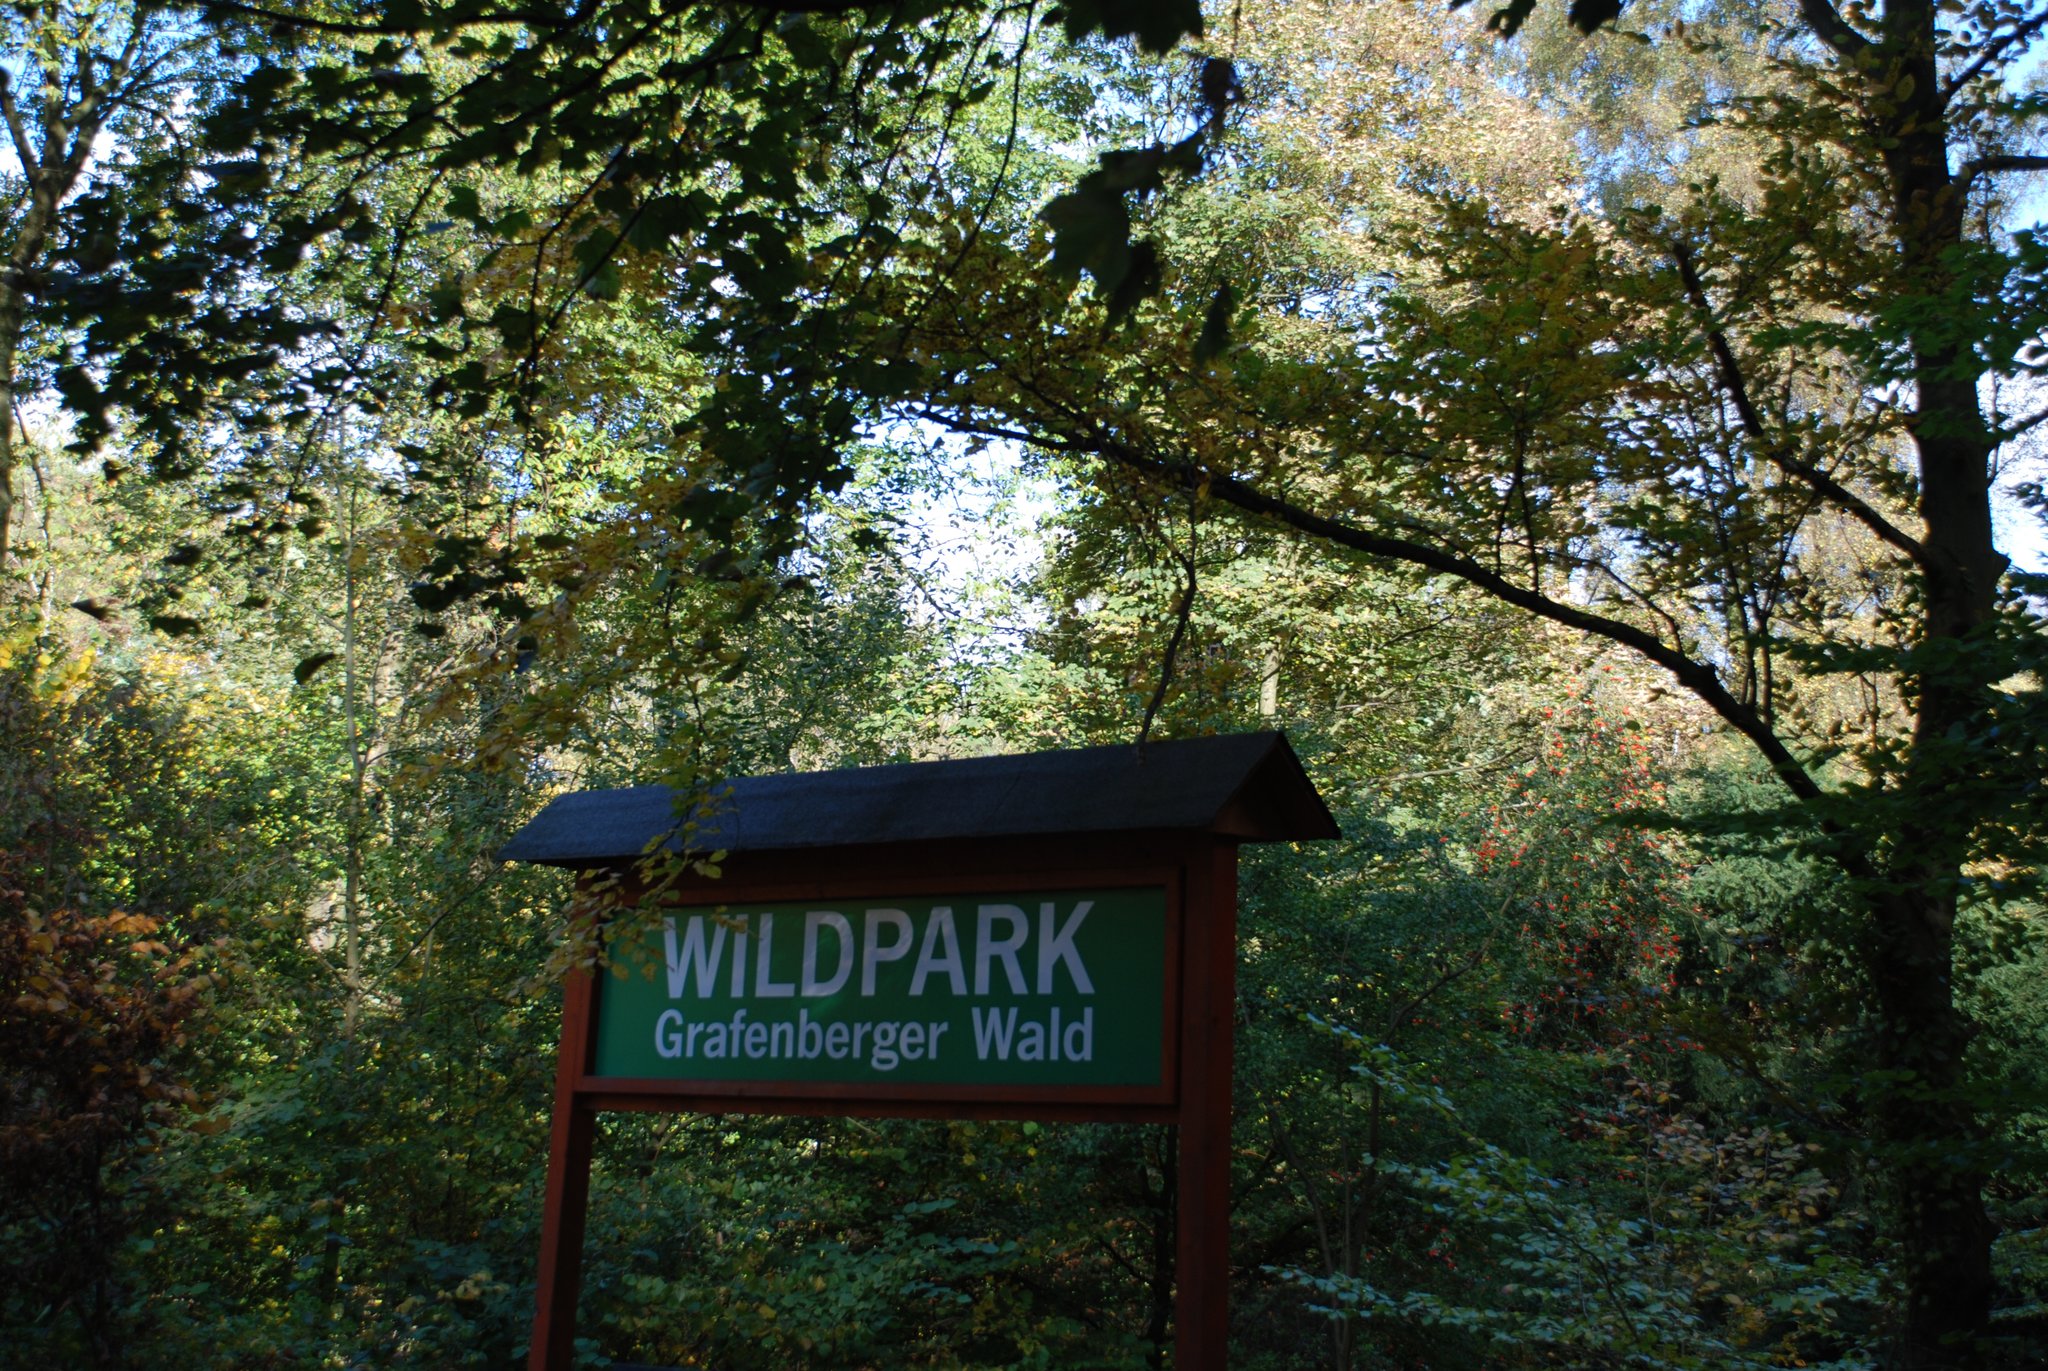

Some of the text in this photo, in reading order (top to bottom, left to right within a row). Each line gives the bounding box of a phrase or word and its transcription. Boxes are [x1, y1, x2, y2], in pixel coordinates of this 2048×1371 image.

[663, 900, 1095, 998] WILDPARK
[655, 1006, 1093, 1071] Grafenberger Wald
